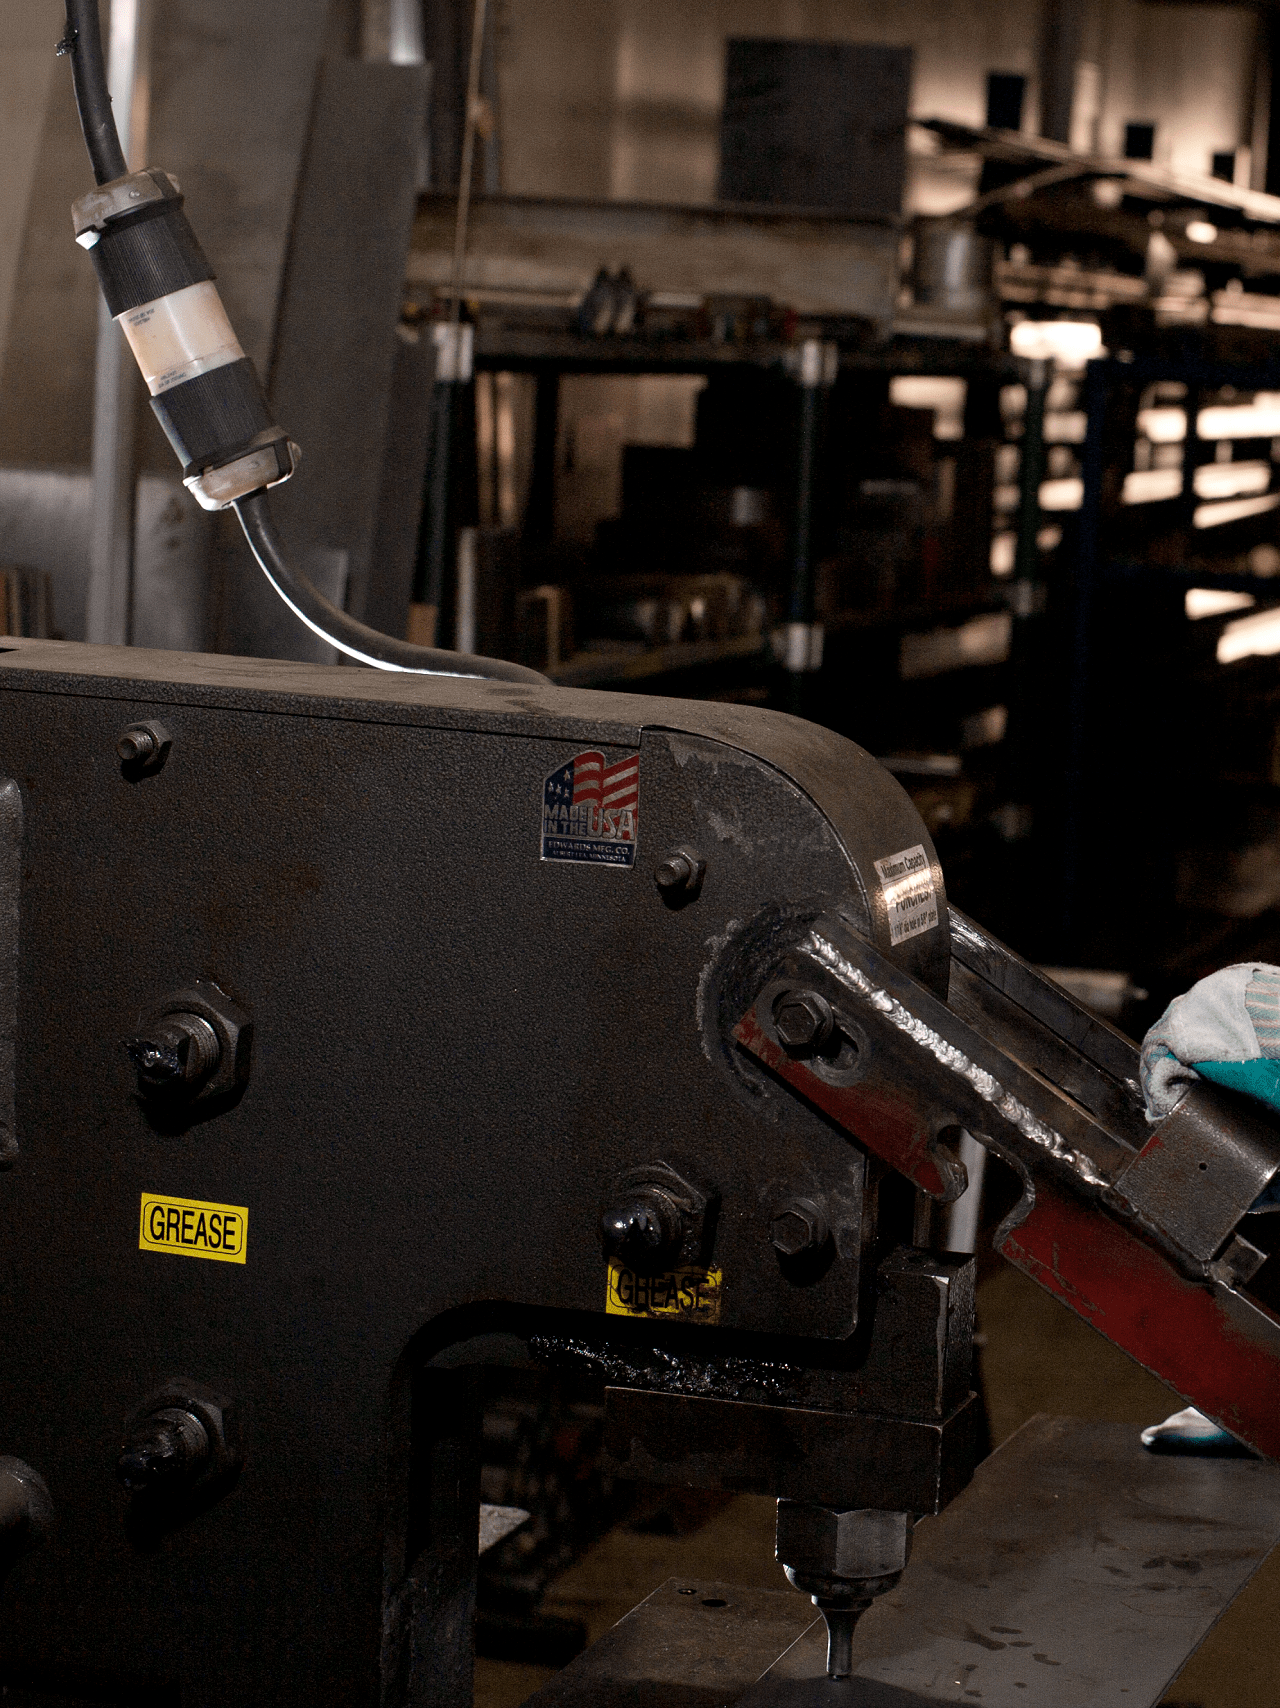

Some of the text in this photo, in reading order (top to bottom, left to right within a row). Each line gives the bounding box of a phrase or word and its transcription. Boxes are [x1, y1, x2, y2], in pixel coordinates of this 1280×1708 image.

[544, 804, 588, 822] MADE
[587, 807, 635, 840] USA
[544, 819, 588, 836] IN THE
[548, 840, 630, 855] EDWARDS MFG. CO.
[880, 852, 926, 879] Maximum Capacity
[150, 1206, 236, 1251] GREASE
